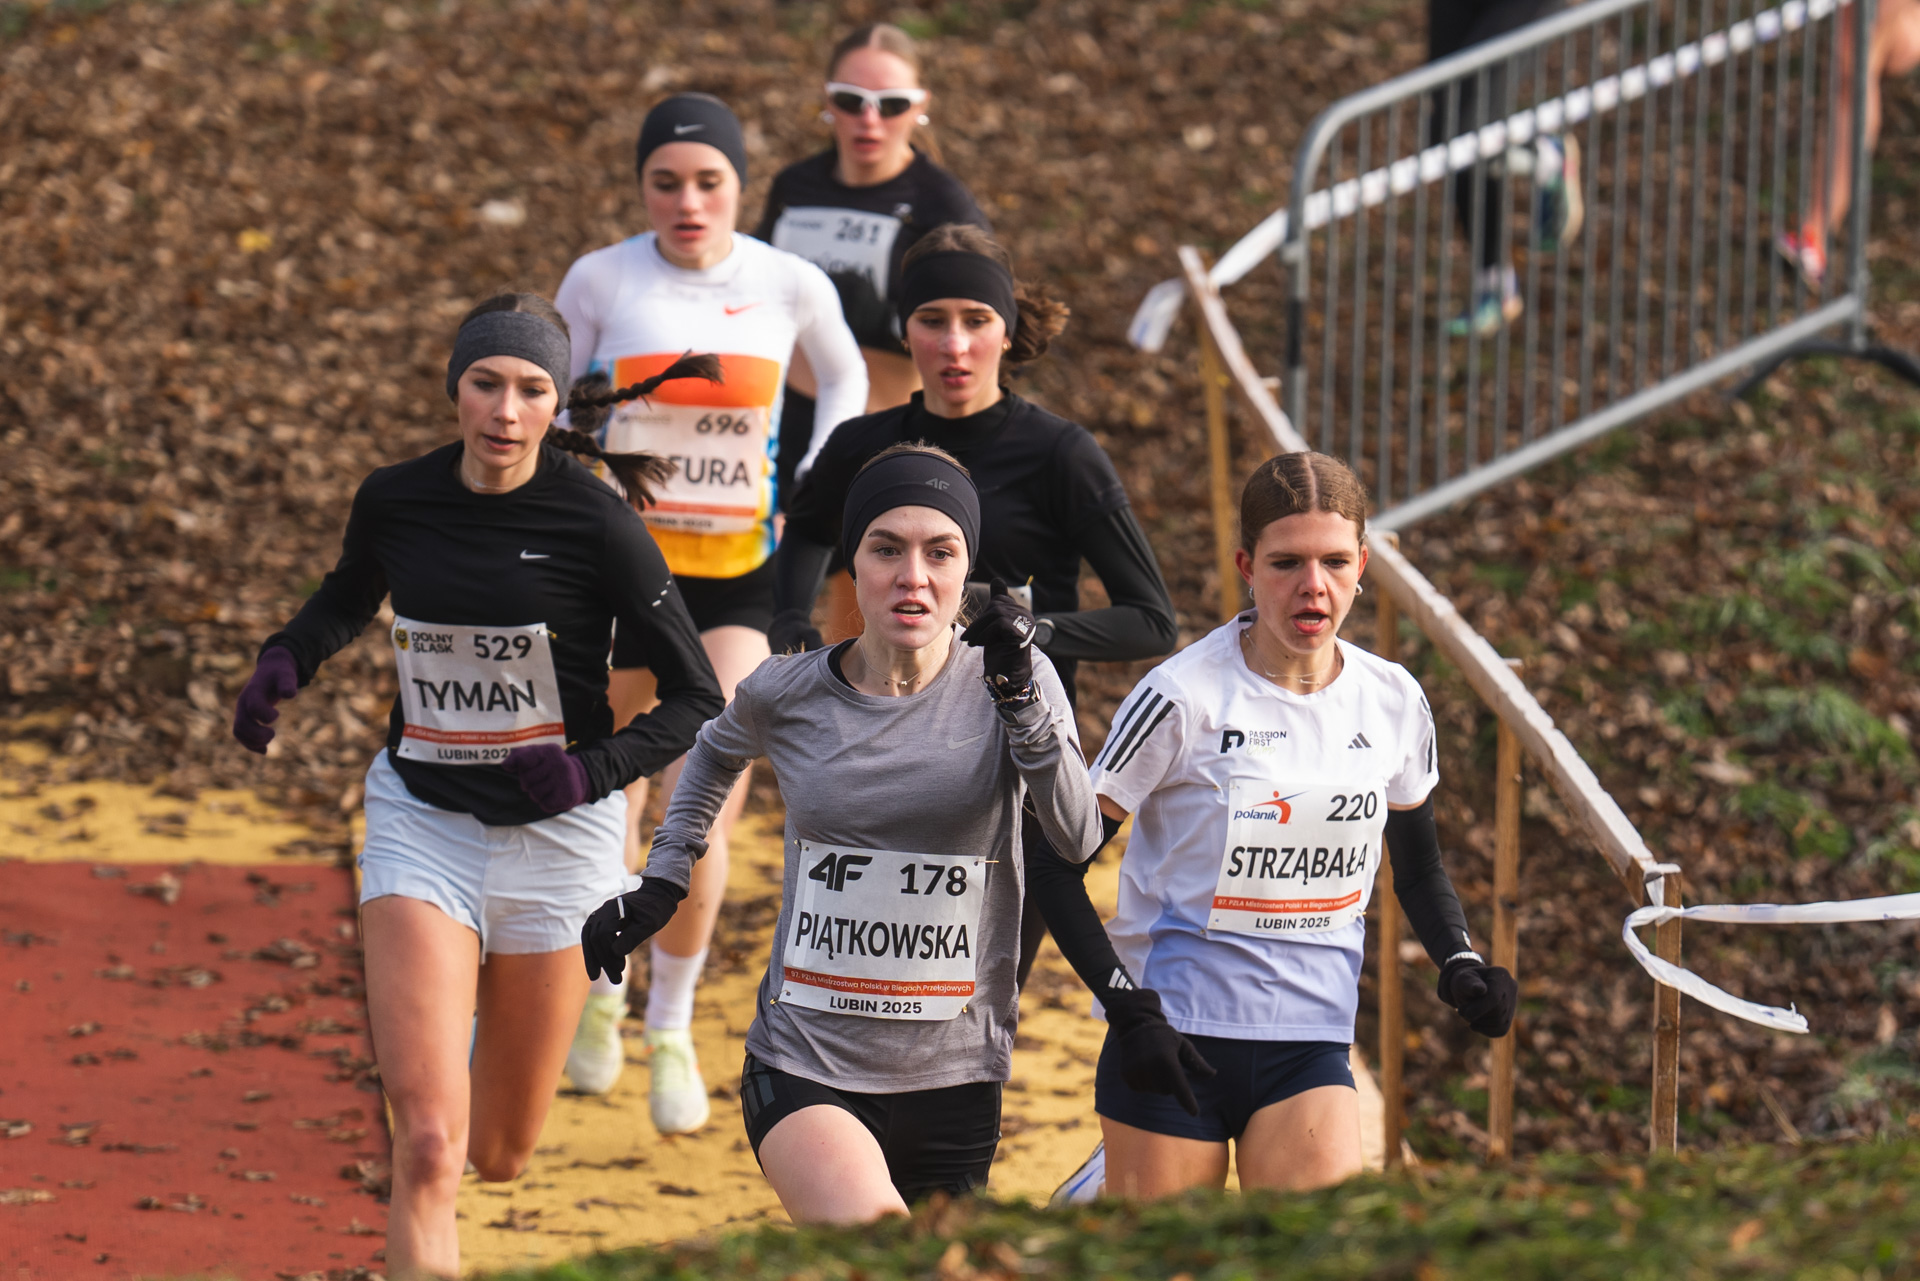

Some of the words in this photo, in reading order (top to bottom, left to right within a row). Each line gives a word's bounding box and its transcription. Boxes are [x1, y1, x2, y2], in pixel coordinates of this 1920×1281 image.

[835, 218, 881, 245] 261
[695, 413, 749, 436] 696
[411, 632, 453, 643] DOLNY
[474, 634, 531, 660] 529
[412, 678, 537, 712] TYMAN
[1249, 738, 1272, 746] FIRST
[437, 748, 479, 760] LUBIN
[482, 748, 510, 759] 202
[1234, 809, 1278, 820] polanik
[1326, 791, 1377, 821] 220
[1227, 843, 1368, 885] STRZĄBAŁA
[900, 863, 967, 896] 178
[1255, 917, 1297, 930] LUBIN
[1299, 916, 1331, 929] 2025
[795, 911, 970, 960] PIĄTKOWSKA
[817, 975, 860, 988] Mistrzostwa
[860, 981, 882, 991] Polski
[891, 984, 922, 994] Biegach
[829, 996, 878, 1013] LUBIN
[881, 1001, 923, 1014] 2025
